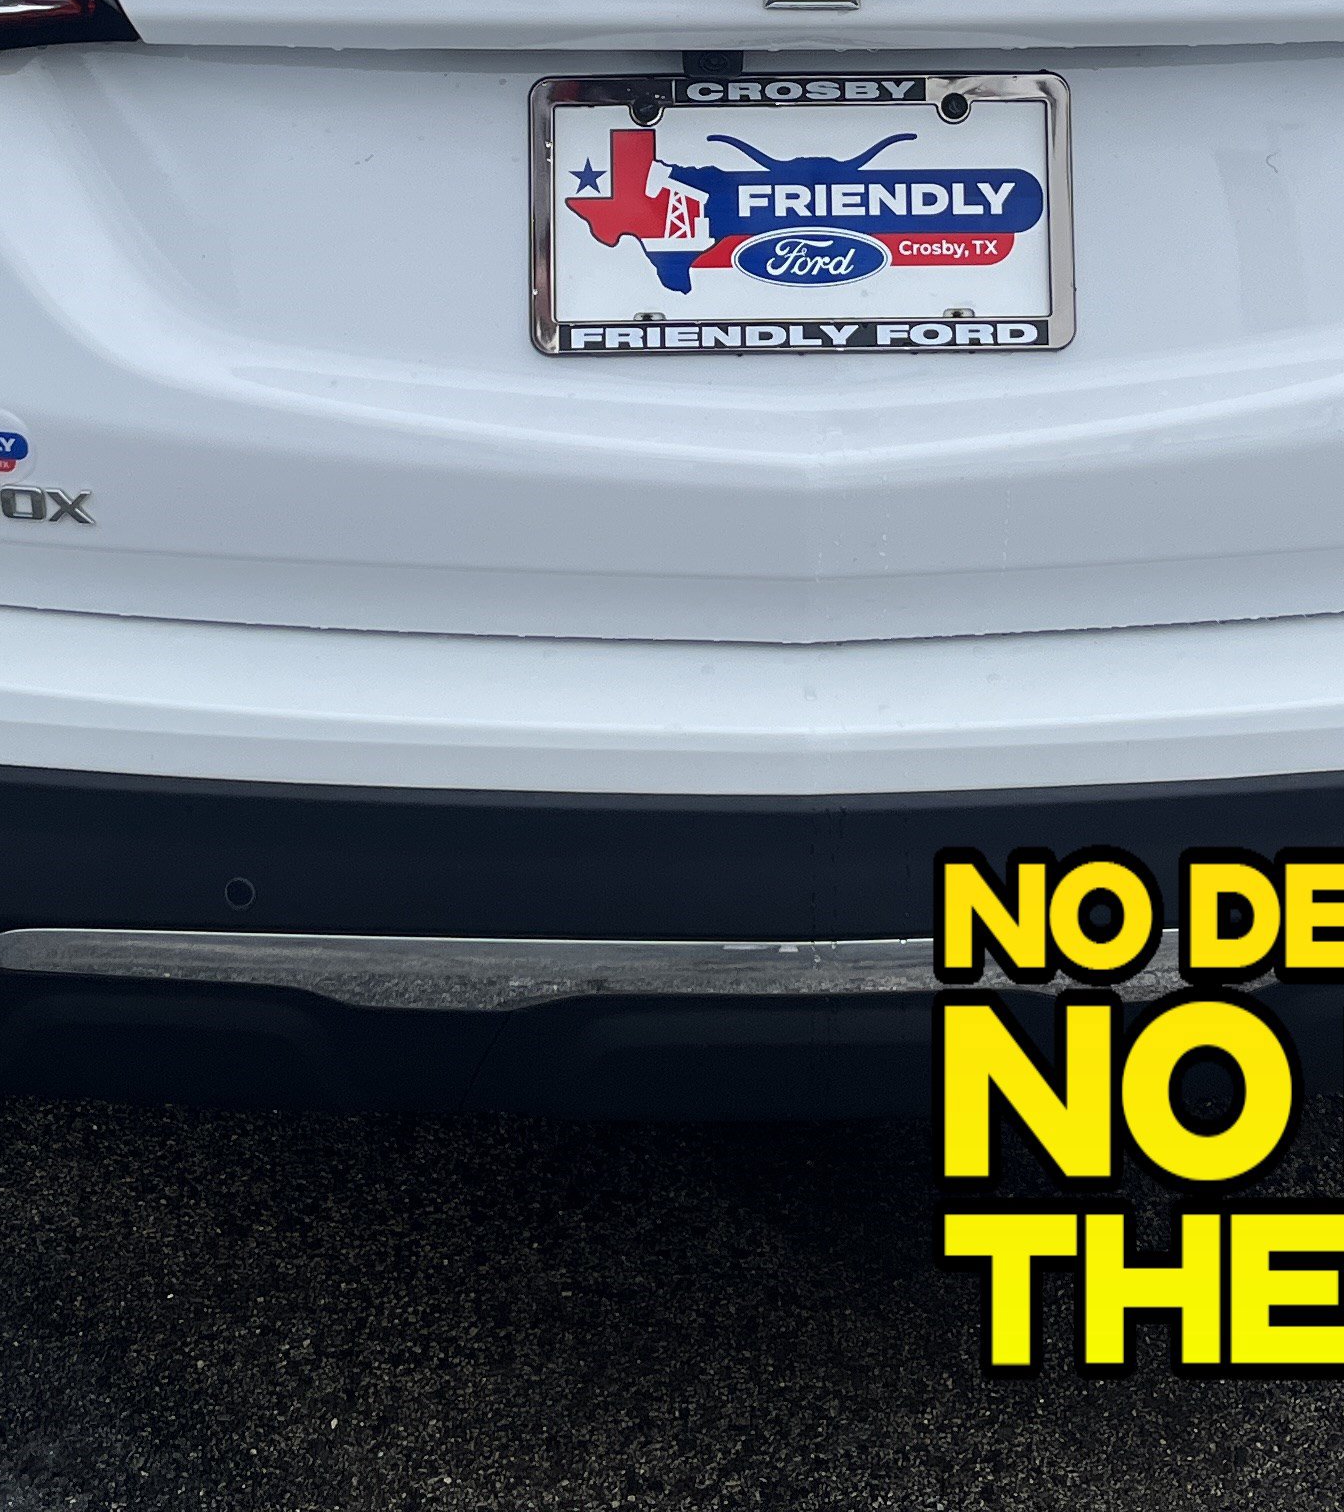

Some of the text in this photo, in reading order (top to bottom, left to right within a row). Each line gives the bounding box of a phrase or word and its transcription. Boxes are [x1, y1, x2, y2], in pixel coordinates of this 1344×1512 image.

[686, 79, 915, 102] CROSBY
[738, 182, 1016, 217] FRIENDLY
[765, 238, 857, 276] Ford
[898, 239, 999, 258] Crosby, TX
[570, 323, 1039, 349] FRIENDLY FORD
